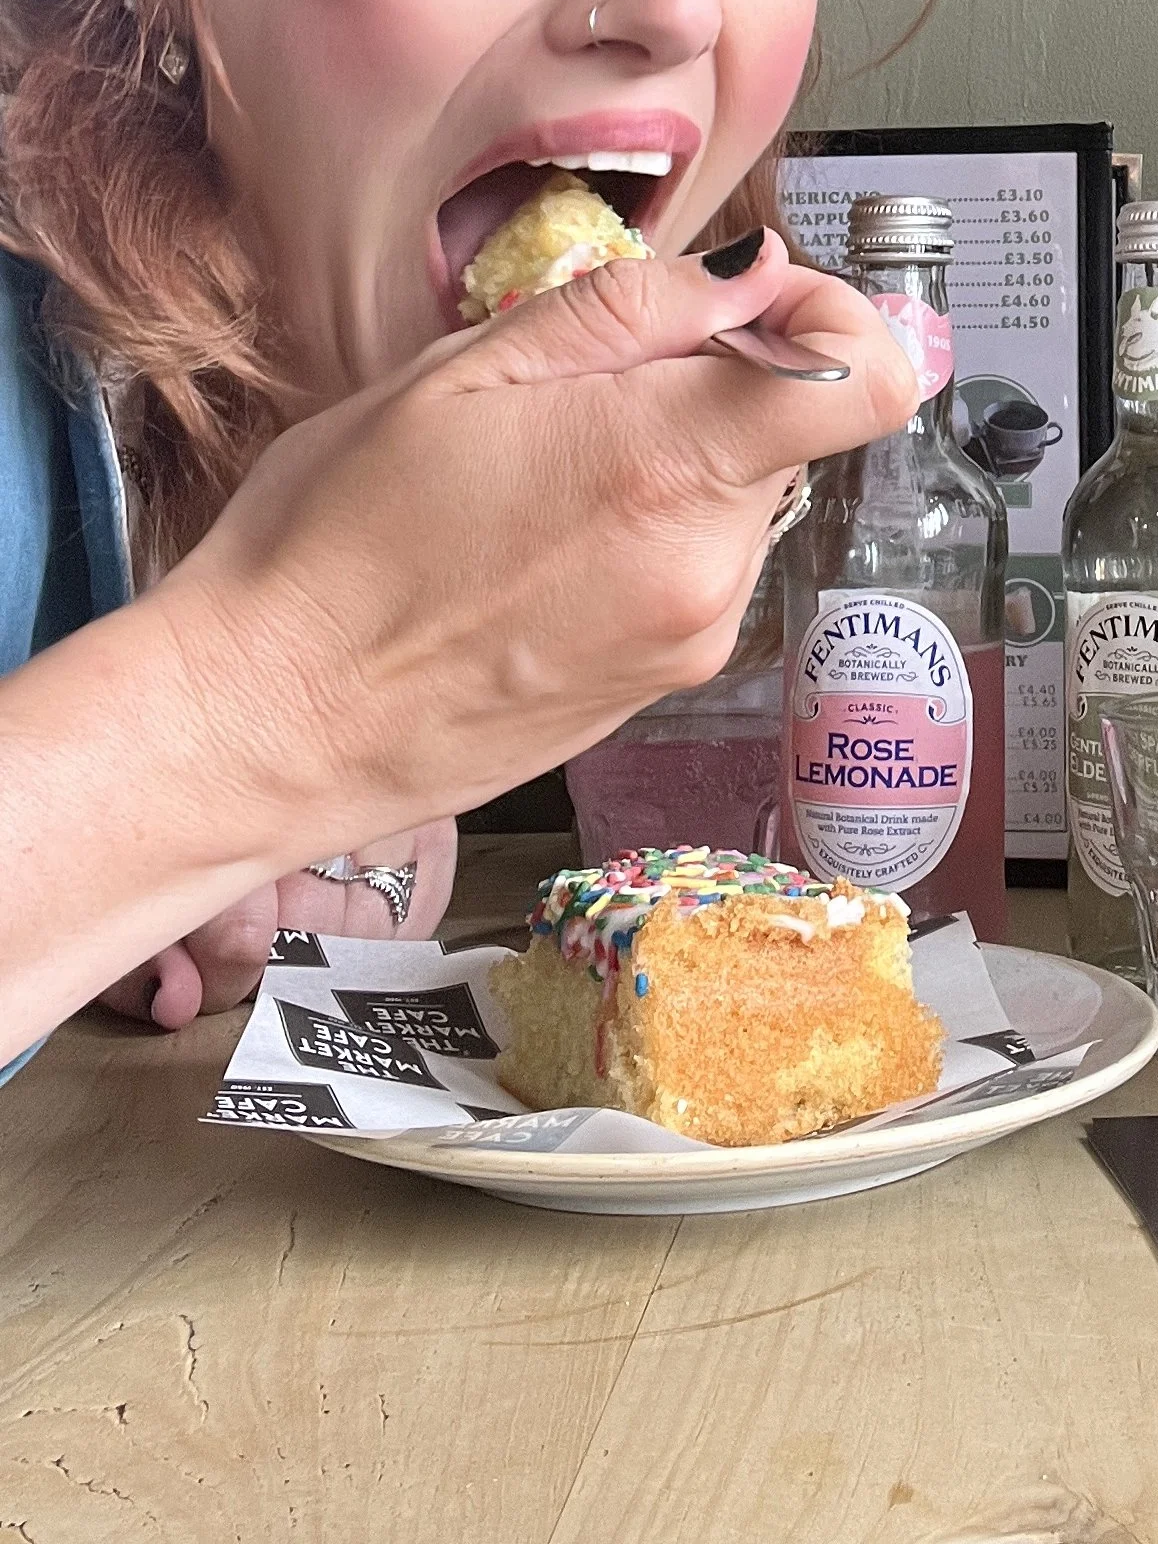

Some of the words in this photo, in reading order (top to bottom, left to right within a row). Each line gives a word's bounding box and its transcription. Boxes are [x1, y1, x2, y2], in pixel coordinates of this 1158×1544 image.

[997, 189, 1043, 202] £3.10
[1000, 210, 1049, 223] £3.60
[1002, 231, 1052, 244] £3.60
[1004, 252, 1053, 265] £3.50
[1003, 273, 1054, 286] £4.60
[1000, 295, 1050, 308] £4.60
[1000, 316, 1050, 329] £4.50
[804, 612, 951, 687] FENTIMANS
[838, 659, 906, 669] BOTANICALLY
[851, 671, 894, 681] BREWED
[1112, 674, 1153, 685] BREWED
[828, 732, 914, 761] ROSE
[796, 755, 957, 789] LEMONADE
[835, 811, 878, 824] Botanical
[880, 814, 909, 825] Drink
[911, 814, 938, 824] made
[838, 824, 858, 835] Pure
[861, 825, 884, 835] Rose
[886, 826, 921, 836] Extract
[818, 848, 872, 878] EXQUISITELY
[875, 852, 919, 877] CRAFTED
[372, 1007, 449, 1023] CAFE
[313, 1023, 393, 1054] CAFE
[298, 1038, 423, 1075] MARKET
[338, 1060, 400, 1079] THE
[214, 1096, 307, 1113] CAFE
